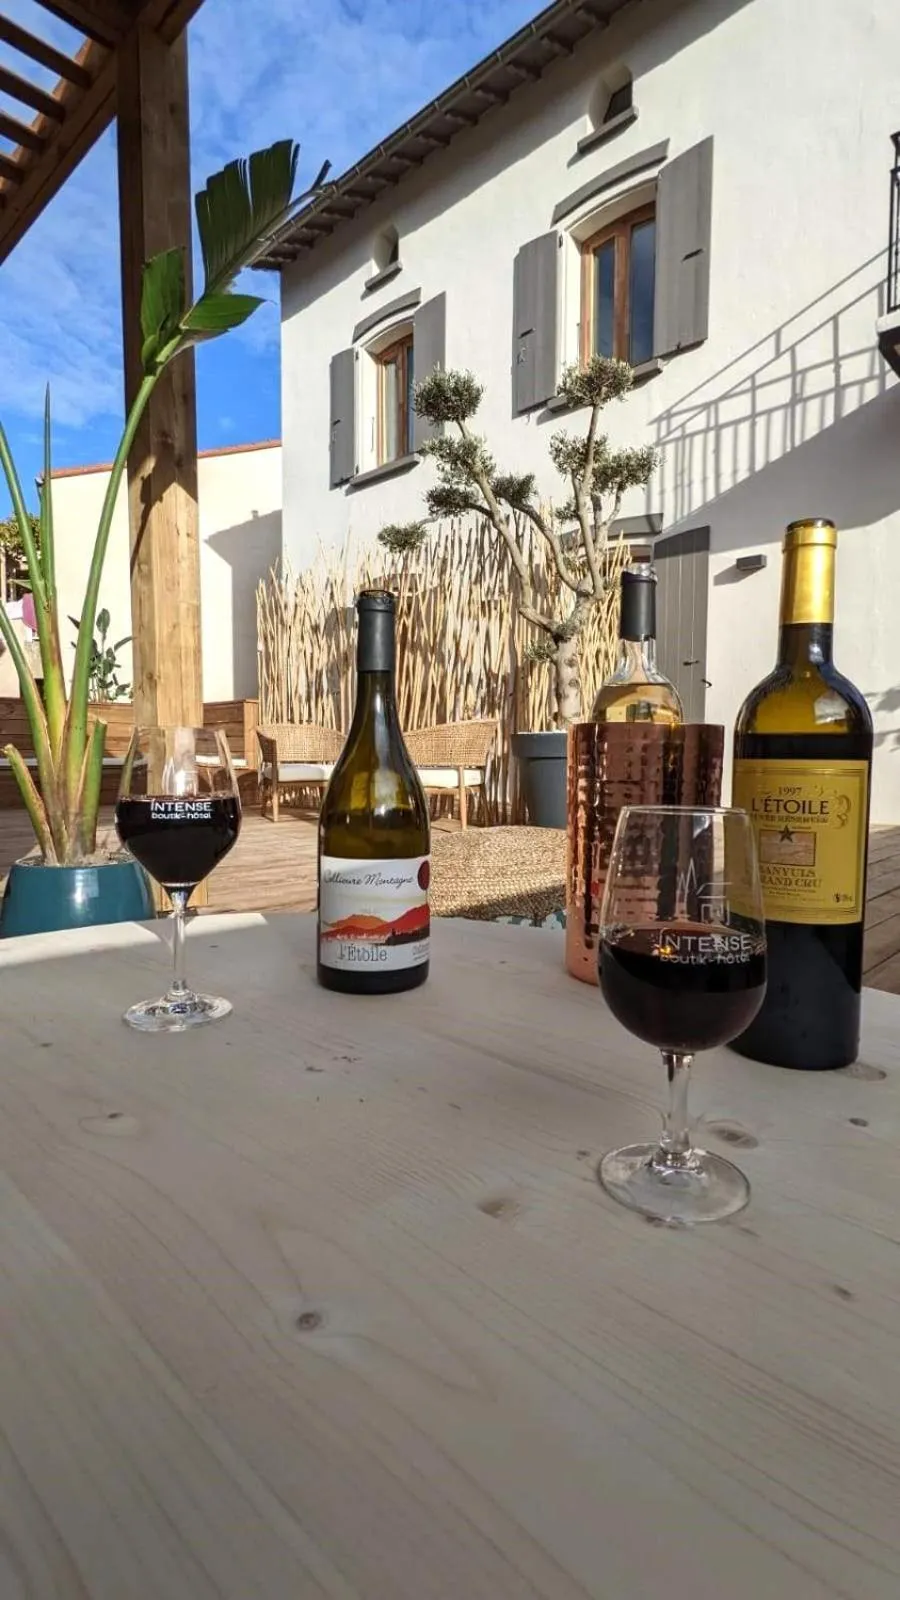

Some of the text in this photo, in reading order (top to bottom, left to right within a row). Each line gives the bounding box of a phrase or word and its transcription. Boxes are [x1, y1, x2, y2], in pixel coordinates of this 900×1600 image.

[778, 786, 802, 795] 1997
[150, 798, 212, 812] INTENSE
[751, 795, 830, 815] L'ÉTOILE
[364, 872, 414, 889] Montagne
[794, 877, 822, 889] CRU
[659, 927, 752, 952] INTENSE
[336, 943, 388, 962] l'Étoile
